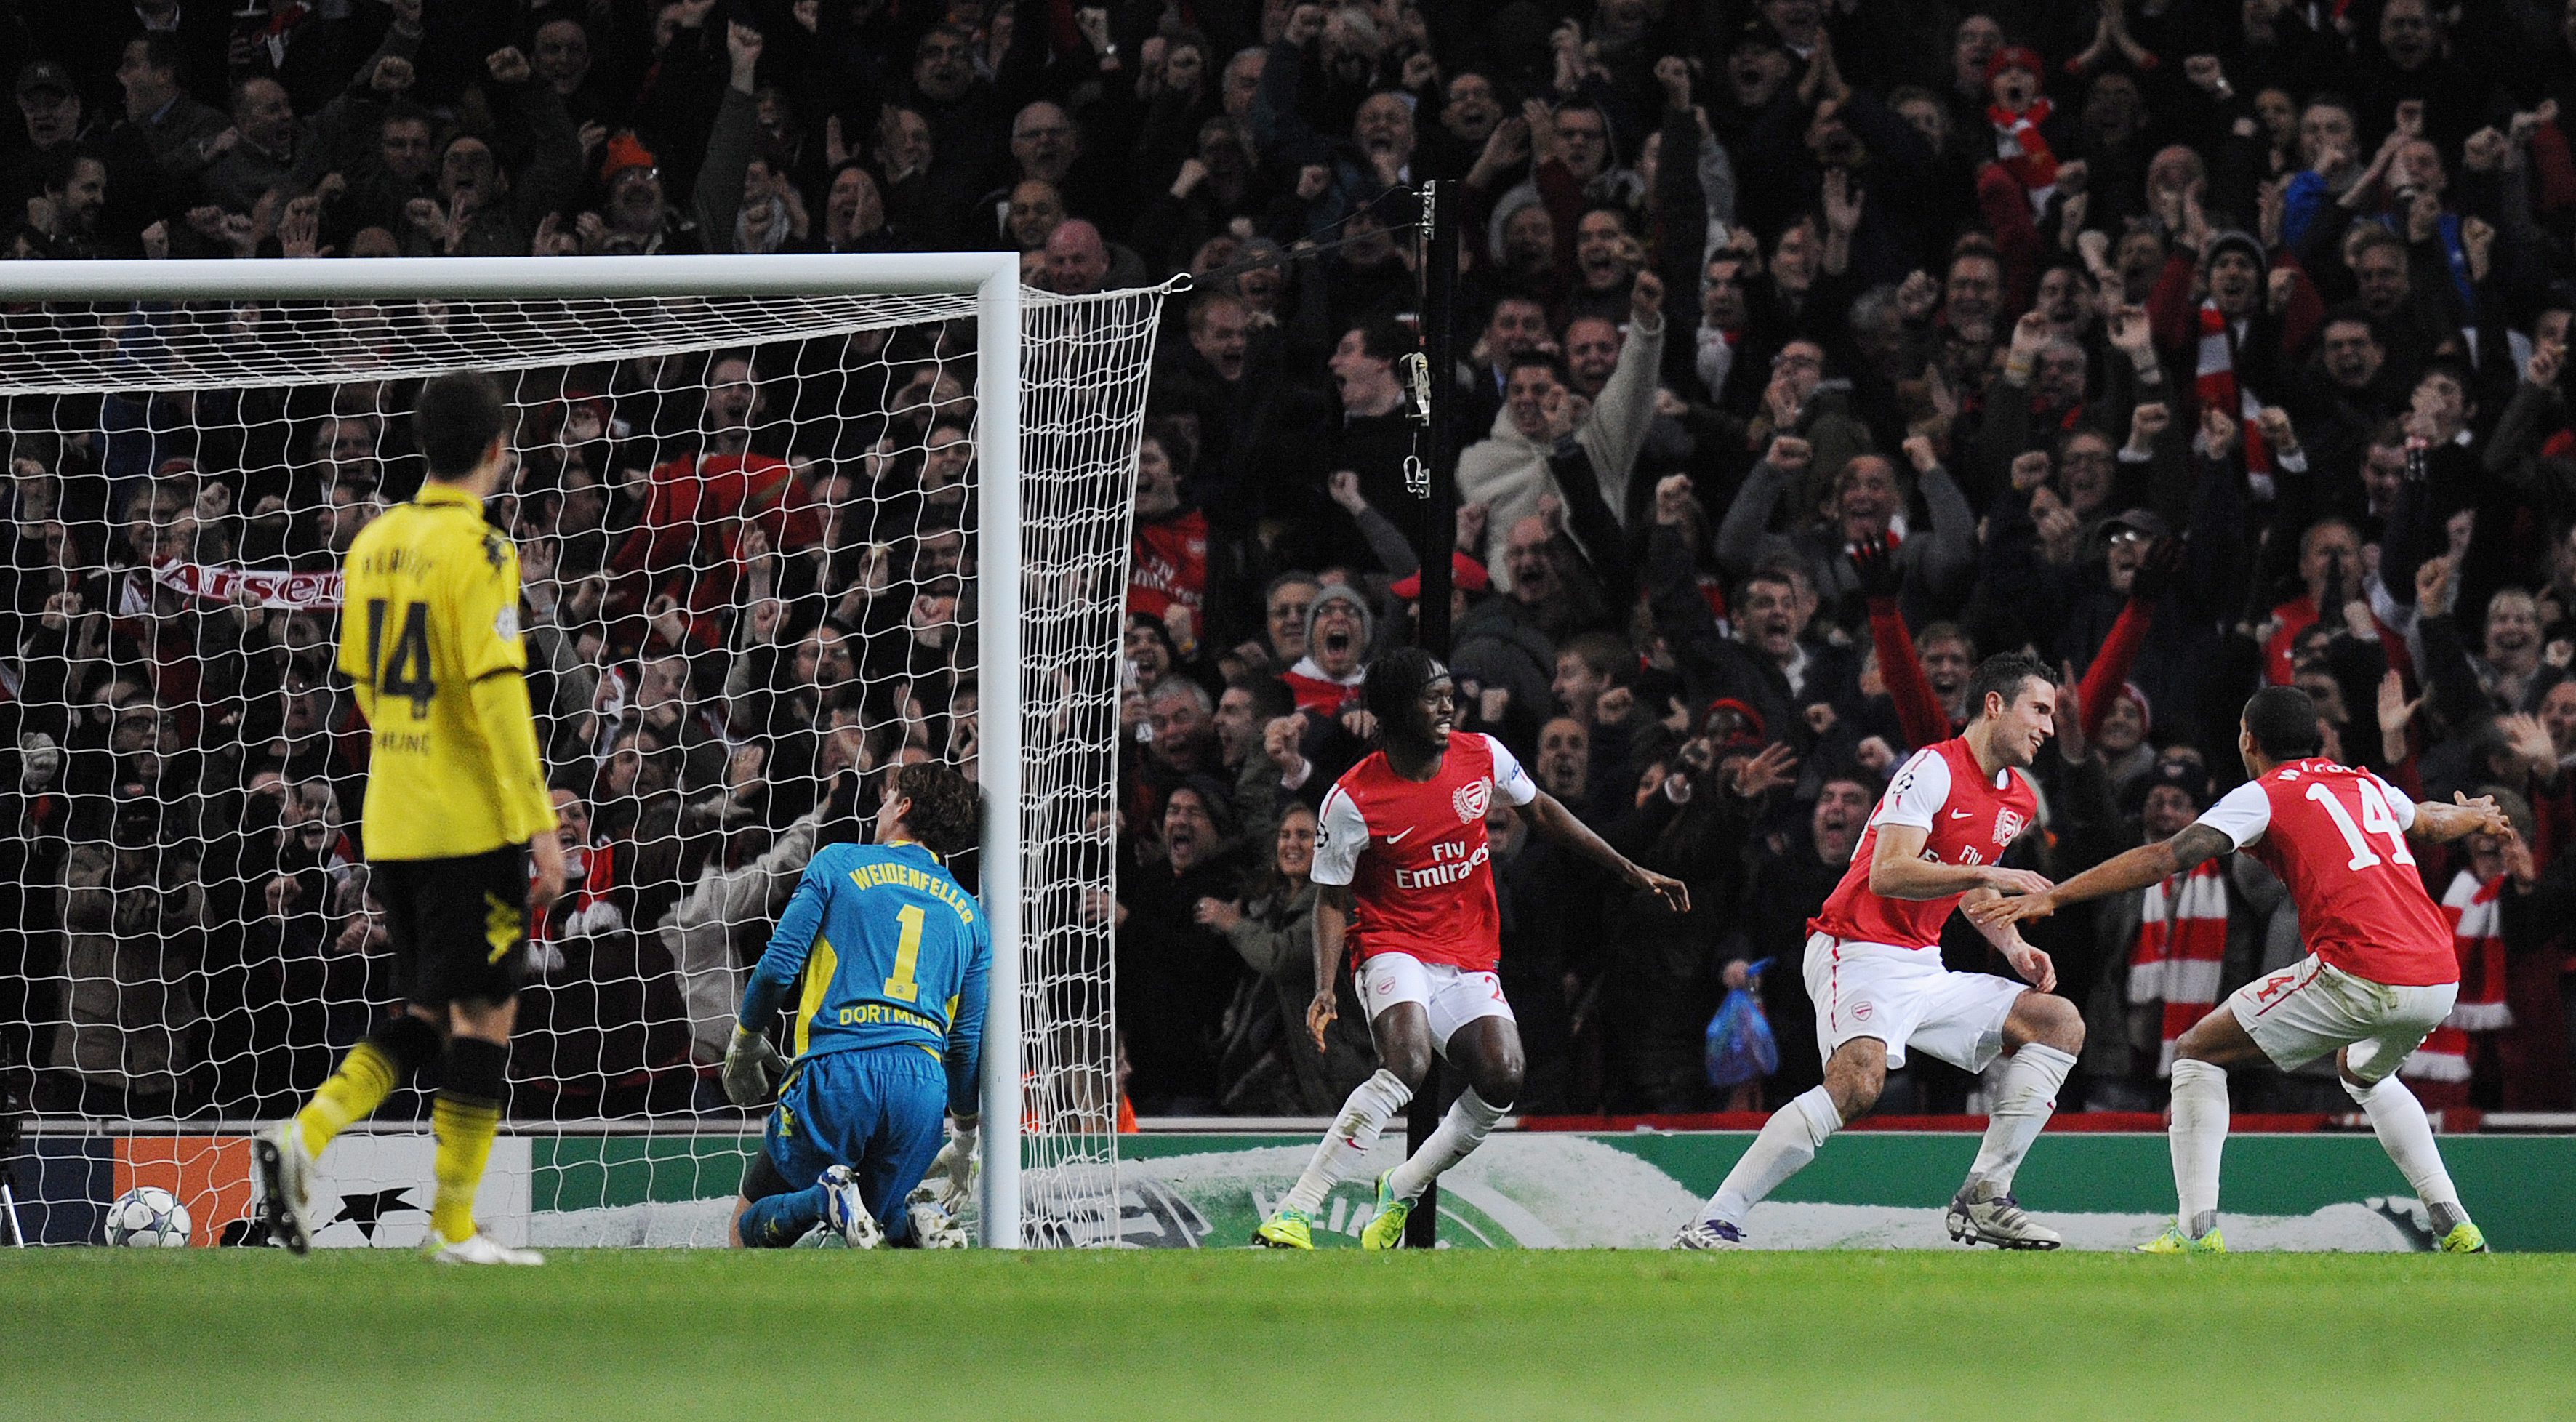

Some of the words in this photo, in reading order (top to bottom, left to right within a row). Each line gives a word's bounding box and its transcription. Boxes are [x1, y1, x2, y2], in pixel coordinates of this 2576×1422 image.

[163, 564, 346, 606] Arsen
[367, 597, 436, 720] 14
[1431, 840, 1466, 862] Fly
[1959, 844, 1983, 867] Fly
[2305, 777, 2417, 872] 14
[848, 862, 974, 925] WEIDENFELLER
[883, 903, 926, 1003] 1
